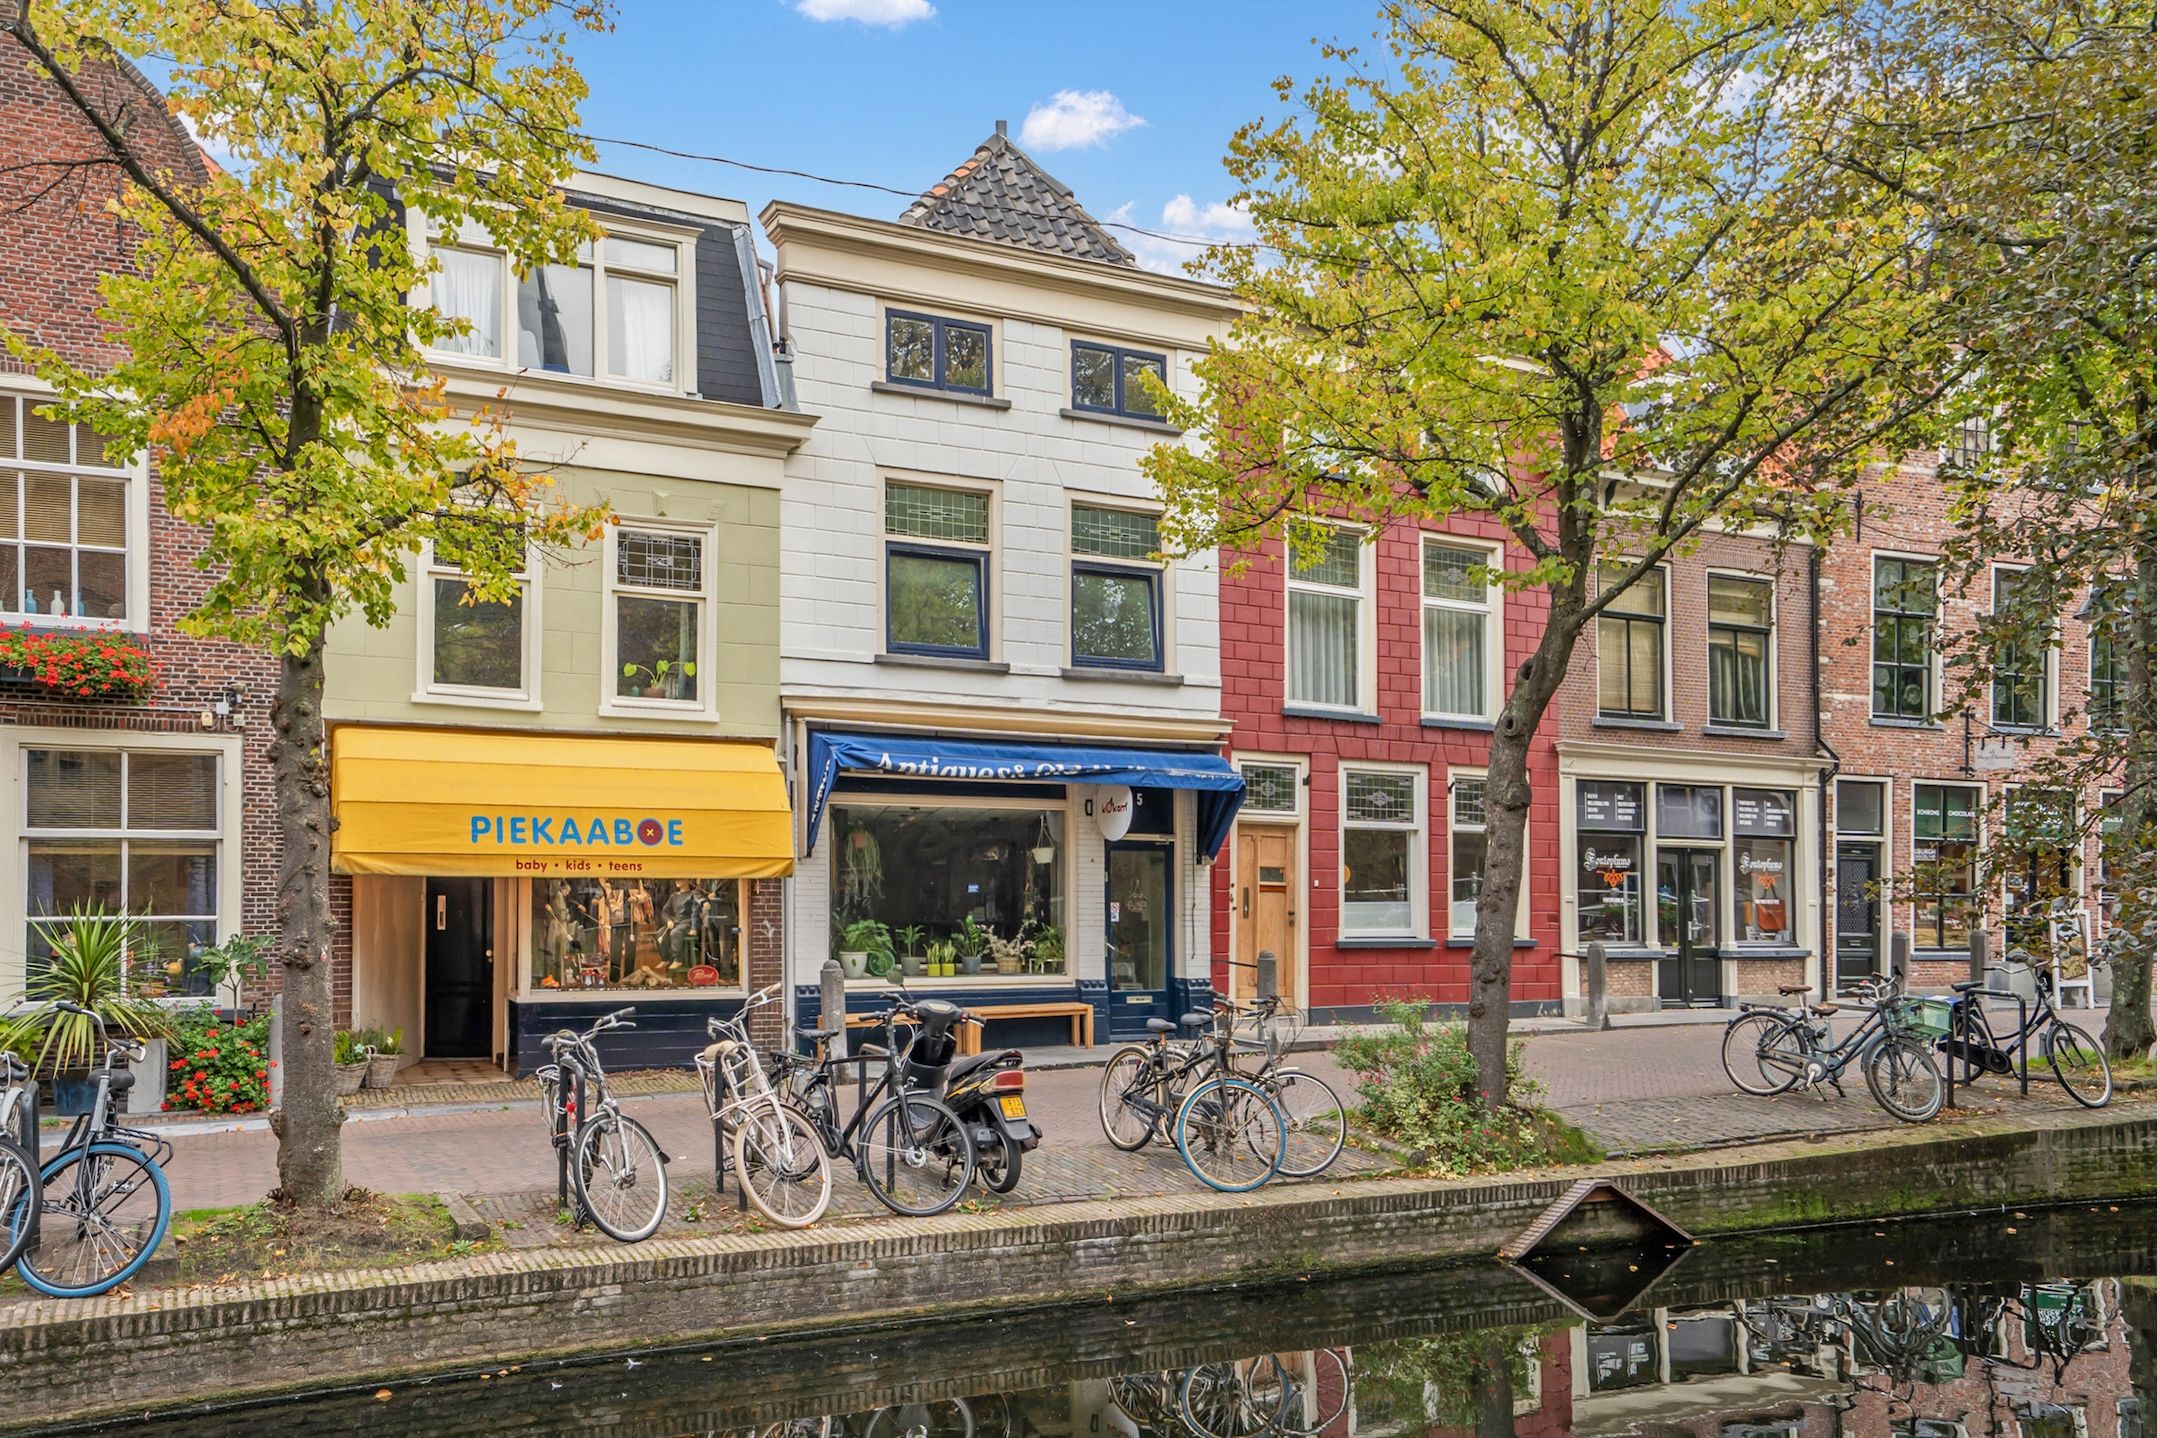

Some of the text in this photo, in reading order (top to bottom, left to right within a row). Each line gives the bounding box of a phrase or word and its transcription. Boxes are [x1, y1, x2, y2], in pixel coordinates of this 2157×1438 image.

[1136, 793, 1143, 806] 5
[471, 815, 684, 846] PIEKAABOE
[516, 860, 643, 872] baby kids teens
